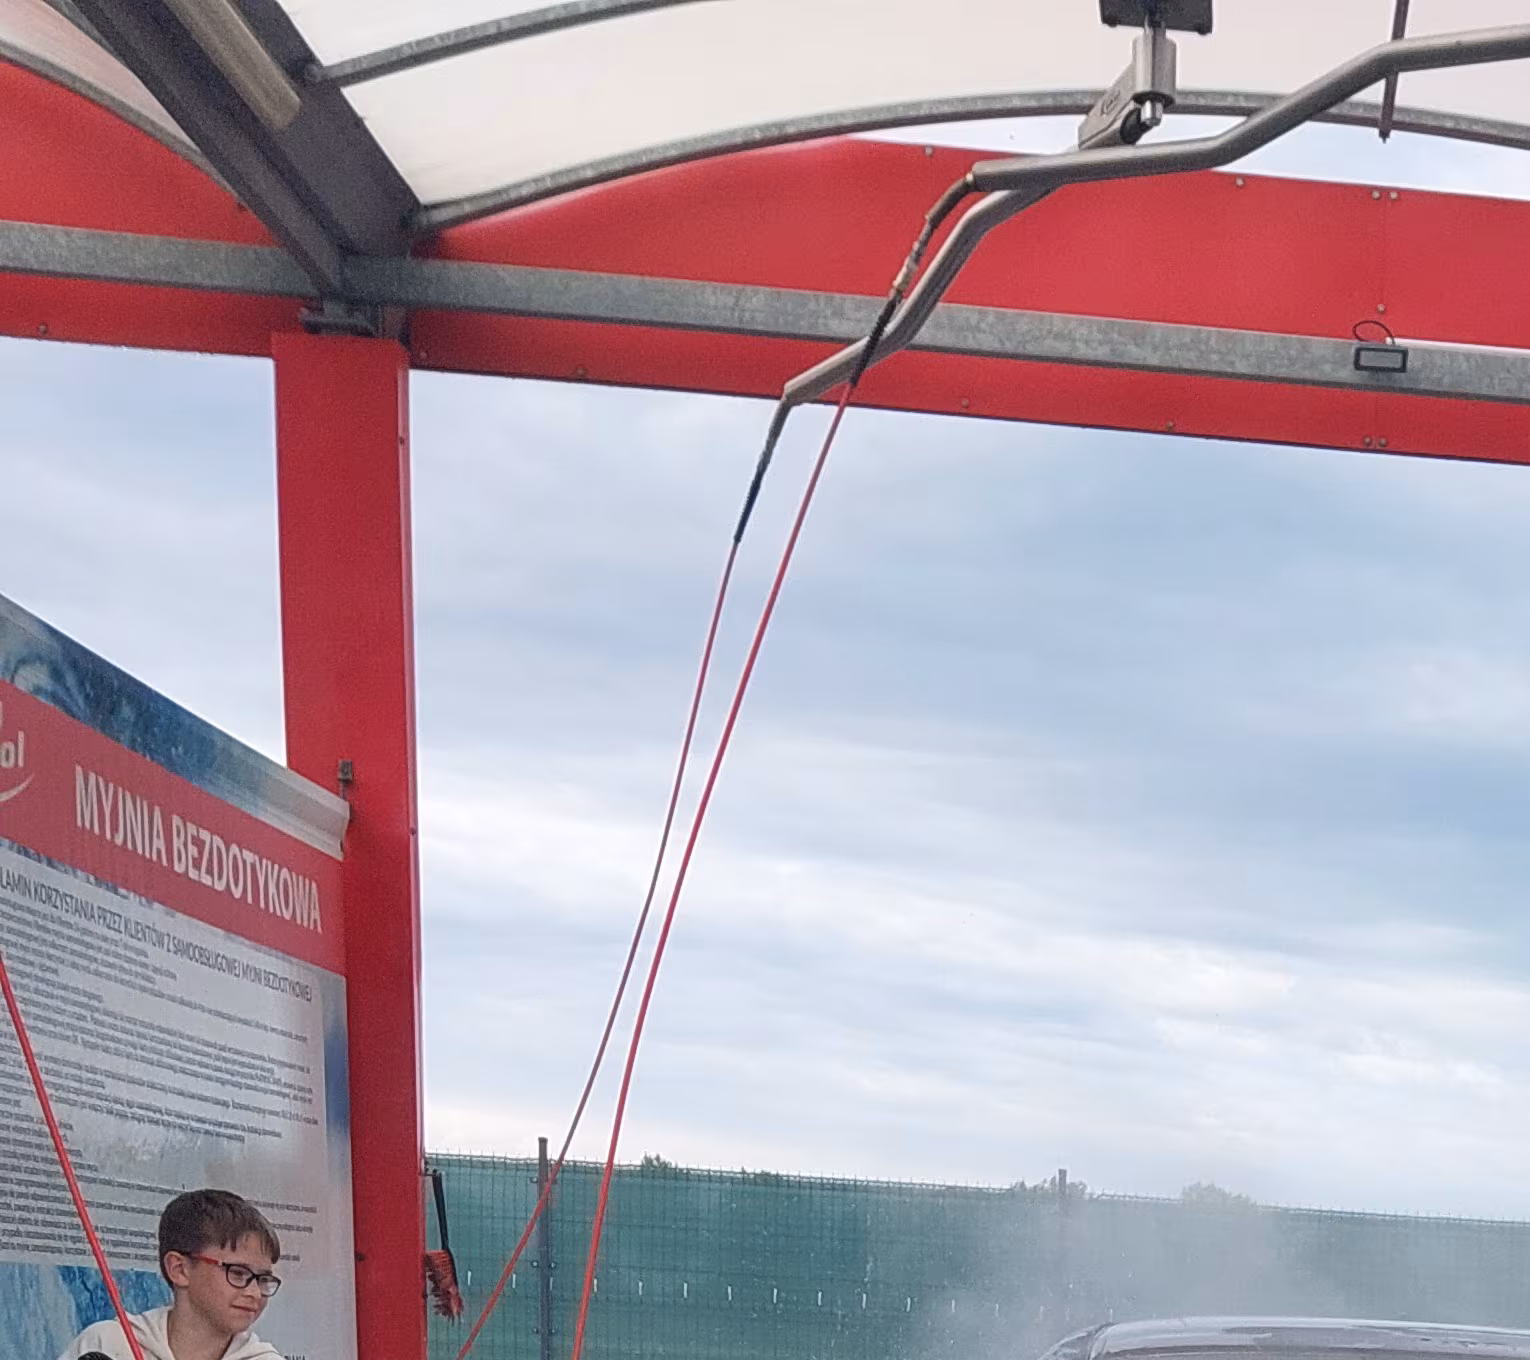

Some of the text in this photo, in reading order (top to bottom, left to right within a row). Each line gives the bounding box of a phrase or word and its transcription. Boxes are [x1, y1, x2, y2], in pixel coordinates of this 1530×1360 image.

[0, 866, 32, 899] LAMIN
[75, 764, 322, 934] MYJNIA BEZDOTYKOWA
